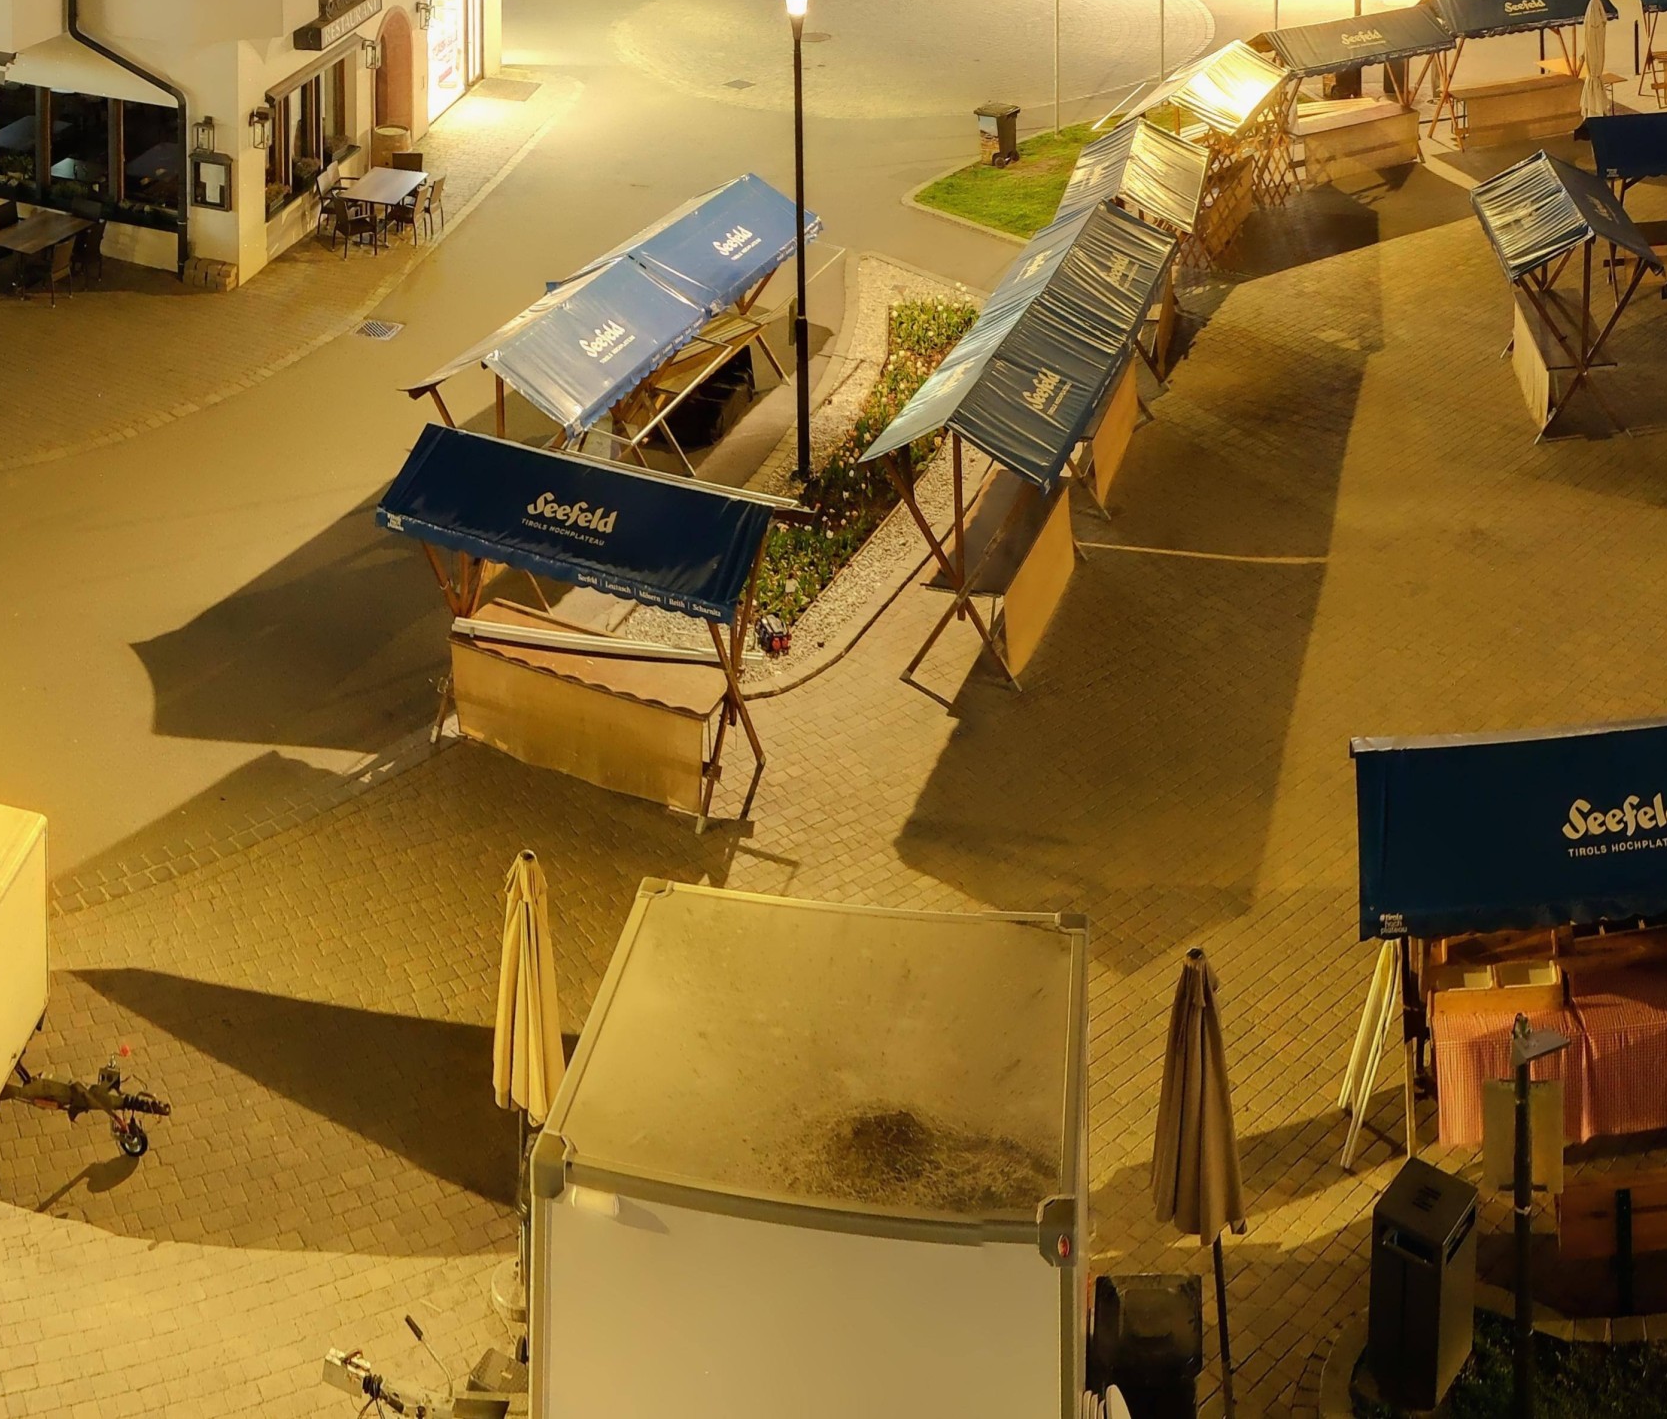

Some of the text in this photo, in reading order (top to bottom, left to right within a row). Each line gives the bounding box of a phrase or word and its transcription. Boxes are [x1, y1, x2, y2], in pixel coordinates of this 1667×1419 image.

[1341, 28, 1383, 45] Seefeld
[713, 225, 753, 256] Seefeld
[579, 320, 626, 358] Seefeld
[1022, 367, 1062, 411] Seefeld
[527, 492, 618, 534] Seefeld
[522, 518, 606, 547] TIROLS HOCHPLATEAU
[1568, 845, 1607, 858] TIROLS
